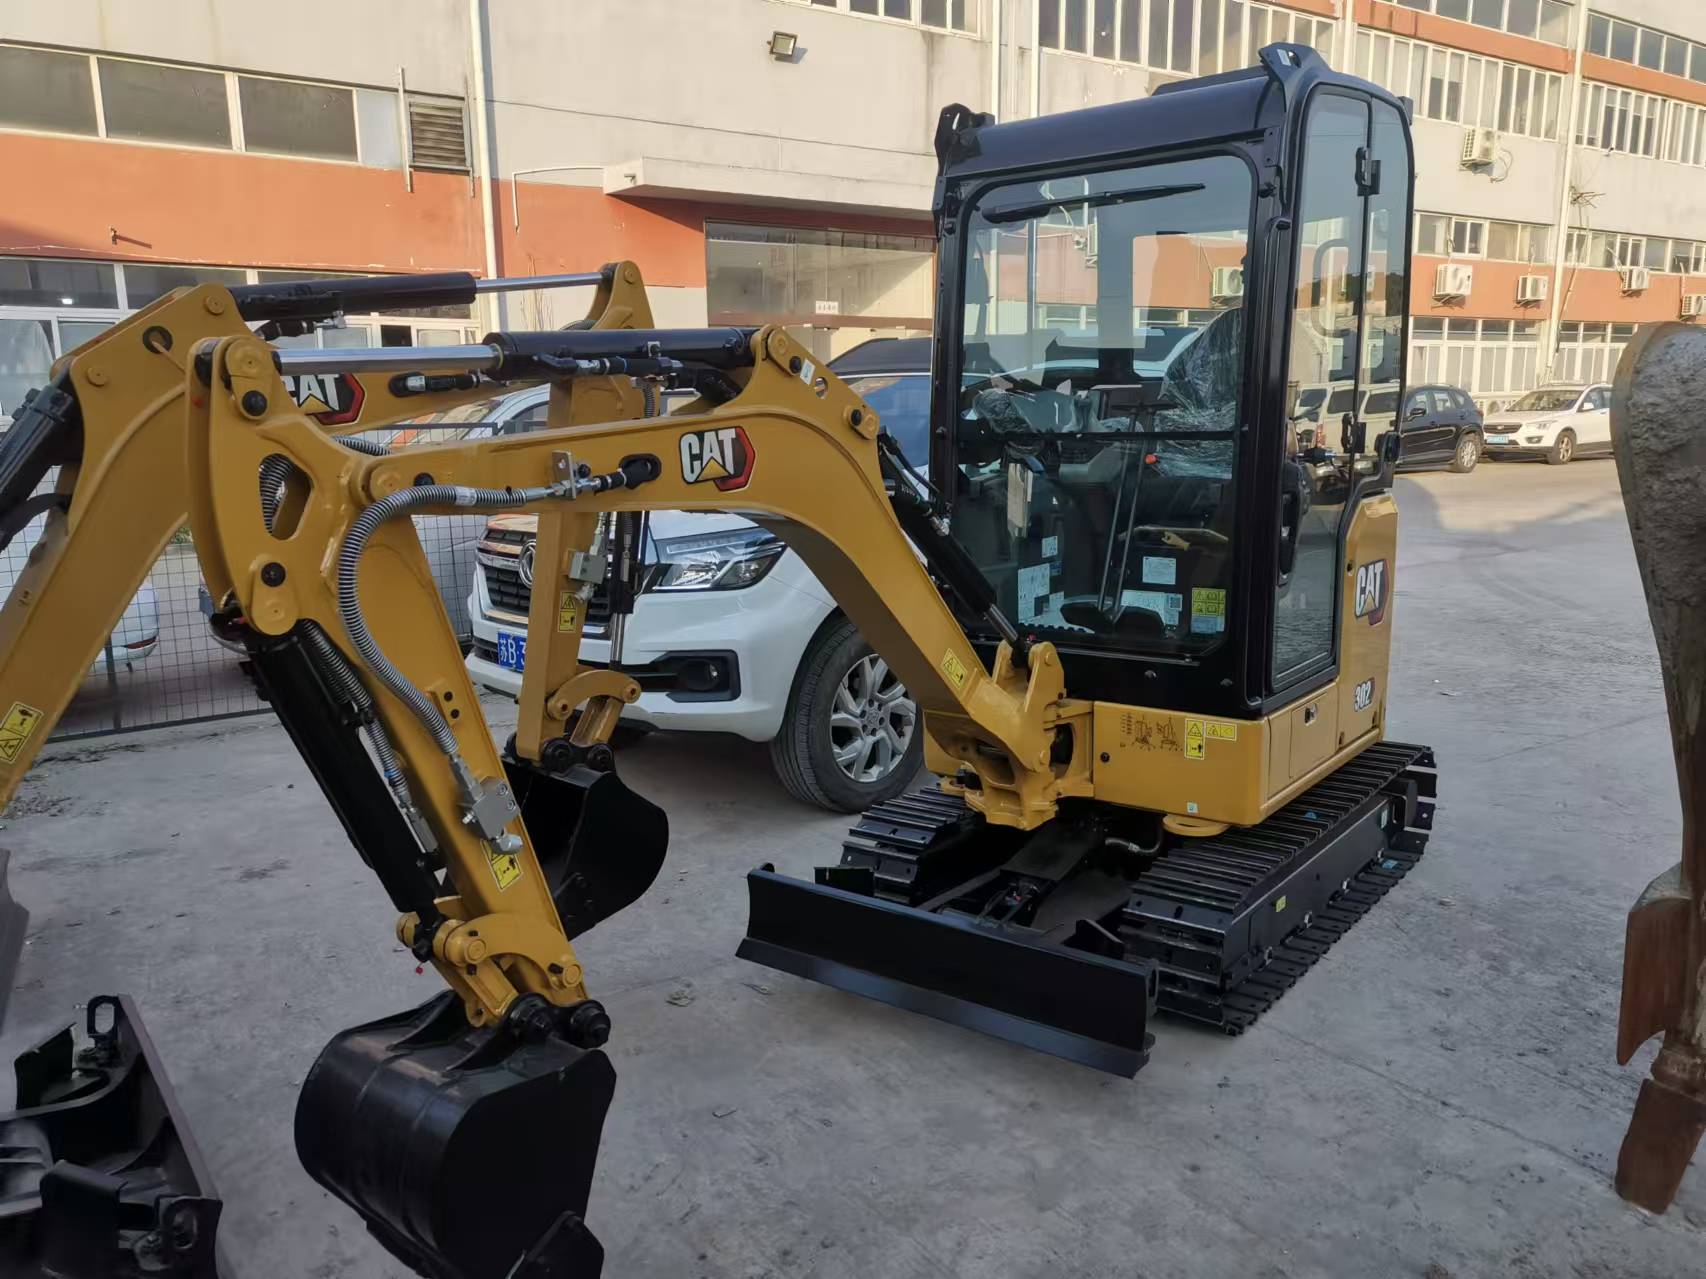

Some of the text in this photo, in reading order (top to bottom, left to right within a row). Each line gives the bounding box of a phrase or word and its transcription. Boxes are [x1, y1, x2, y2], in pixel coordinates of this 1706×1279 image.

[680, 428, 736, 482] CAT
[1356, 561, 1384, 616] CAT
[1355, 681, 1371, 711] 302
